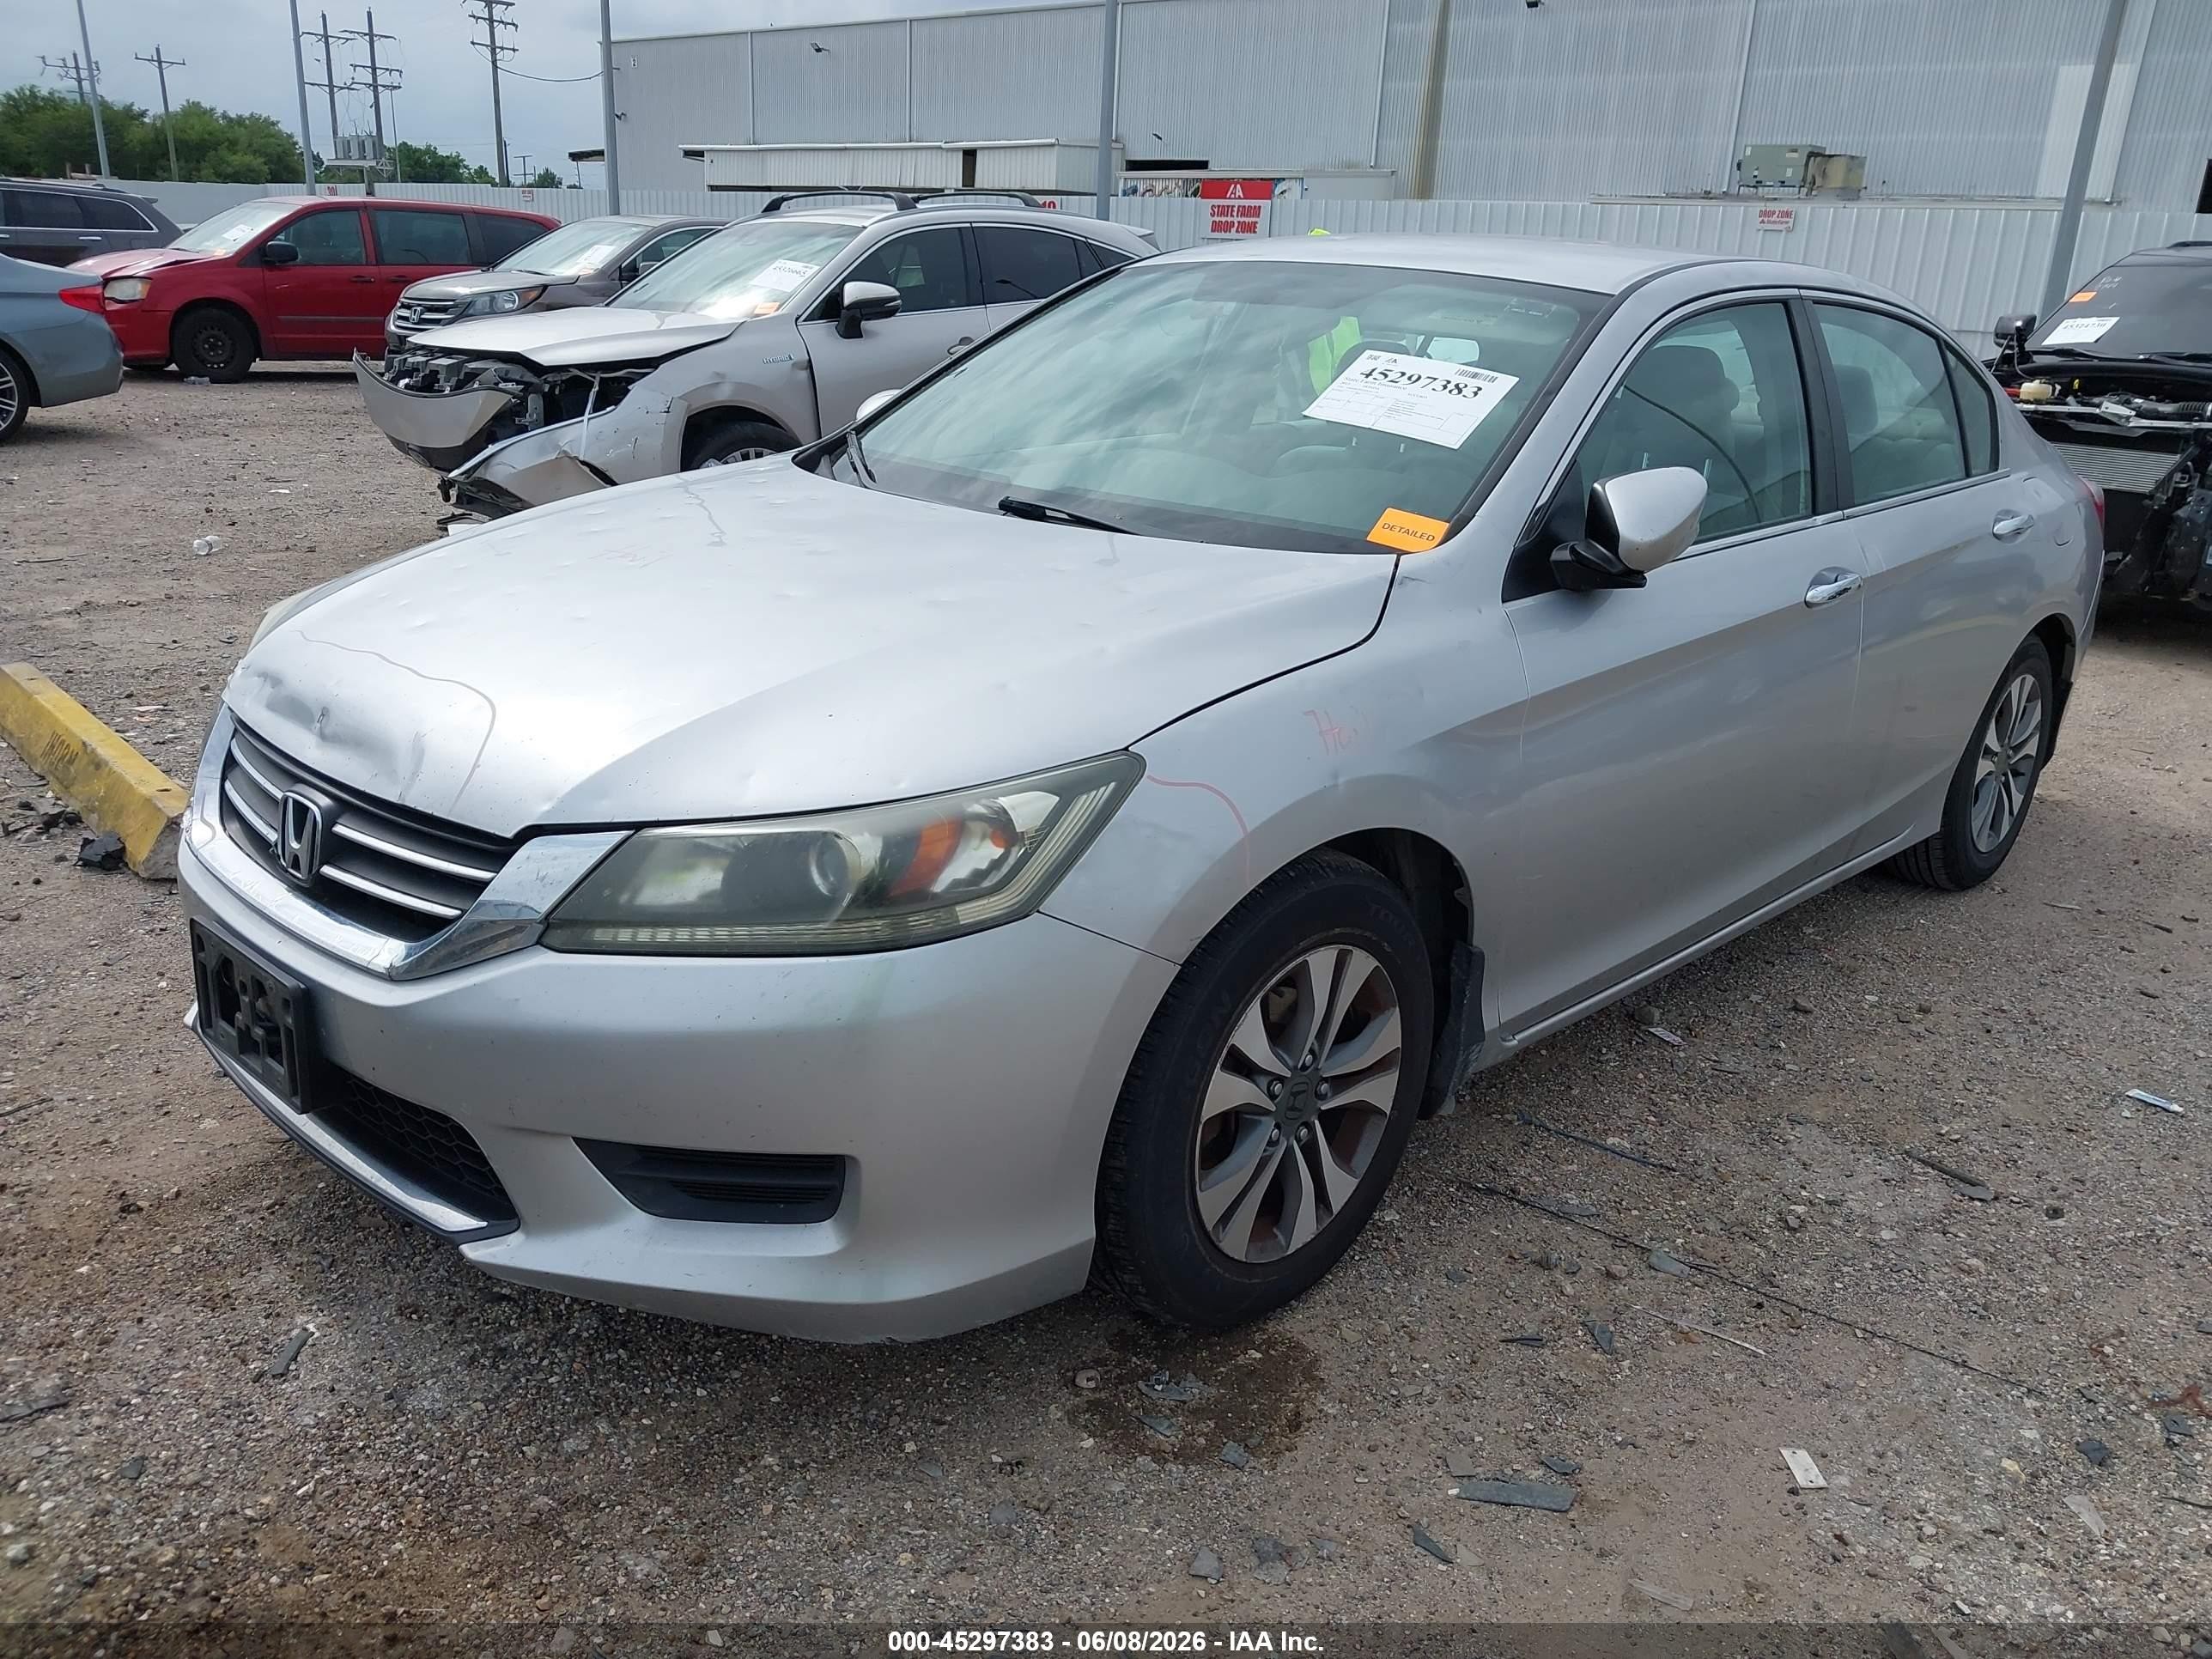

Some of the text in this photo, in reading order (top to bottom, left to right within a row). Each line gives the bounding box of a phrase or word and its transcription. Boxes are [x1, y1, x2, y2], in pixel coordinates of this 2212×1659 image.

[1210, 204, 1261, 218] STATE FARM
[1759, 210, 1794, 219] DROP ZONE
[1211, 221, 1259, 234] DROP ZONE
[1359, 367, 1483, 399] 45297383
[1382, 522, 1436, 542] DETAILED
